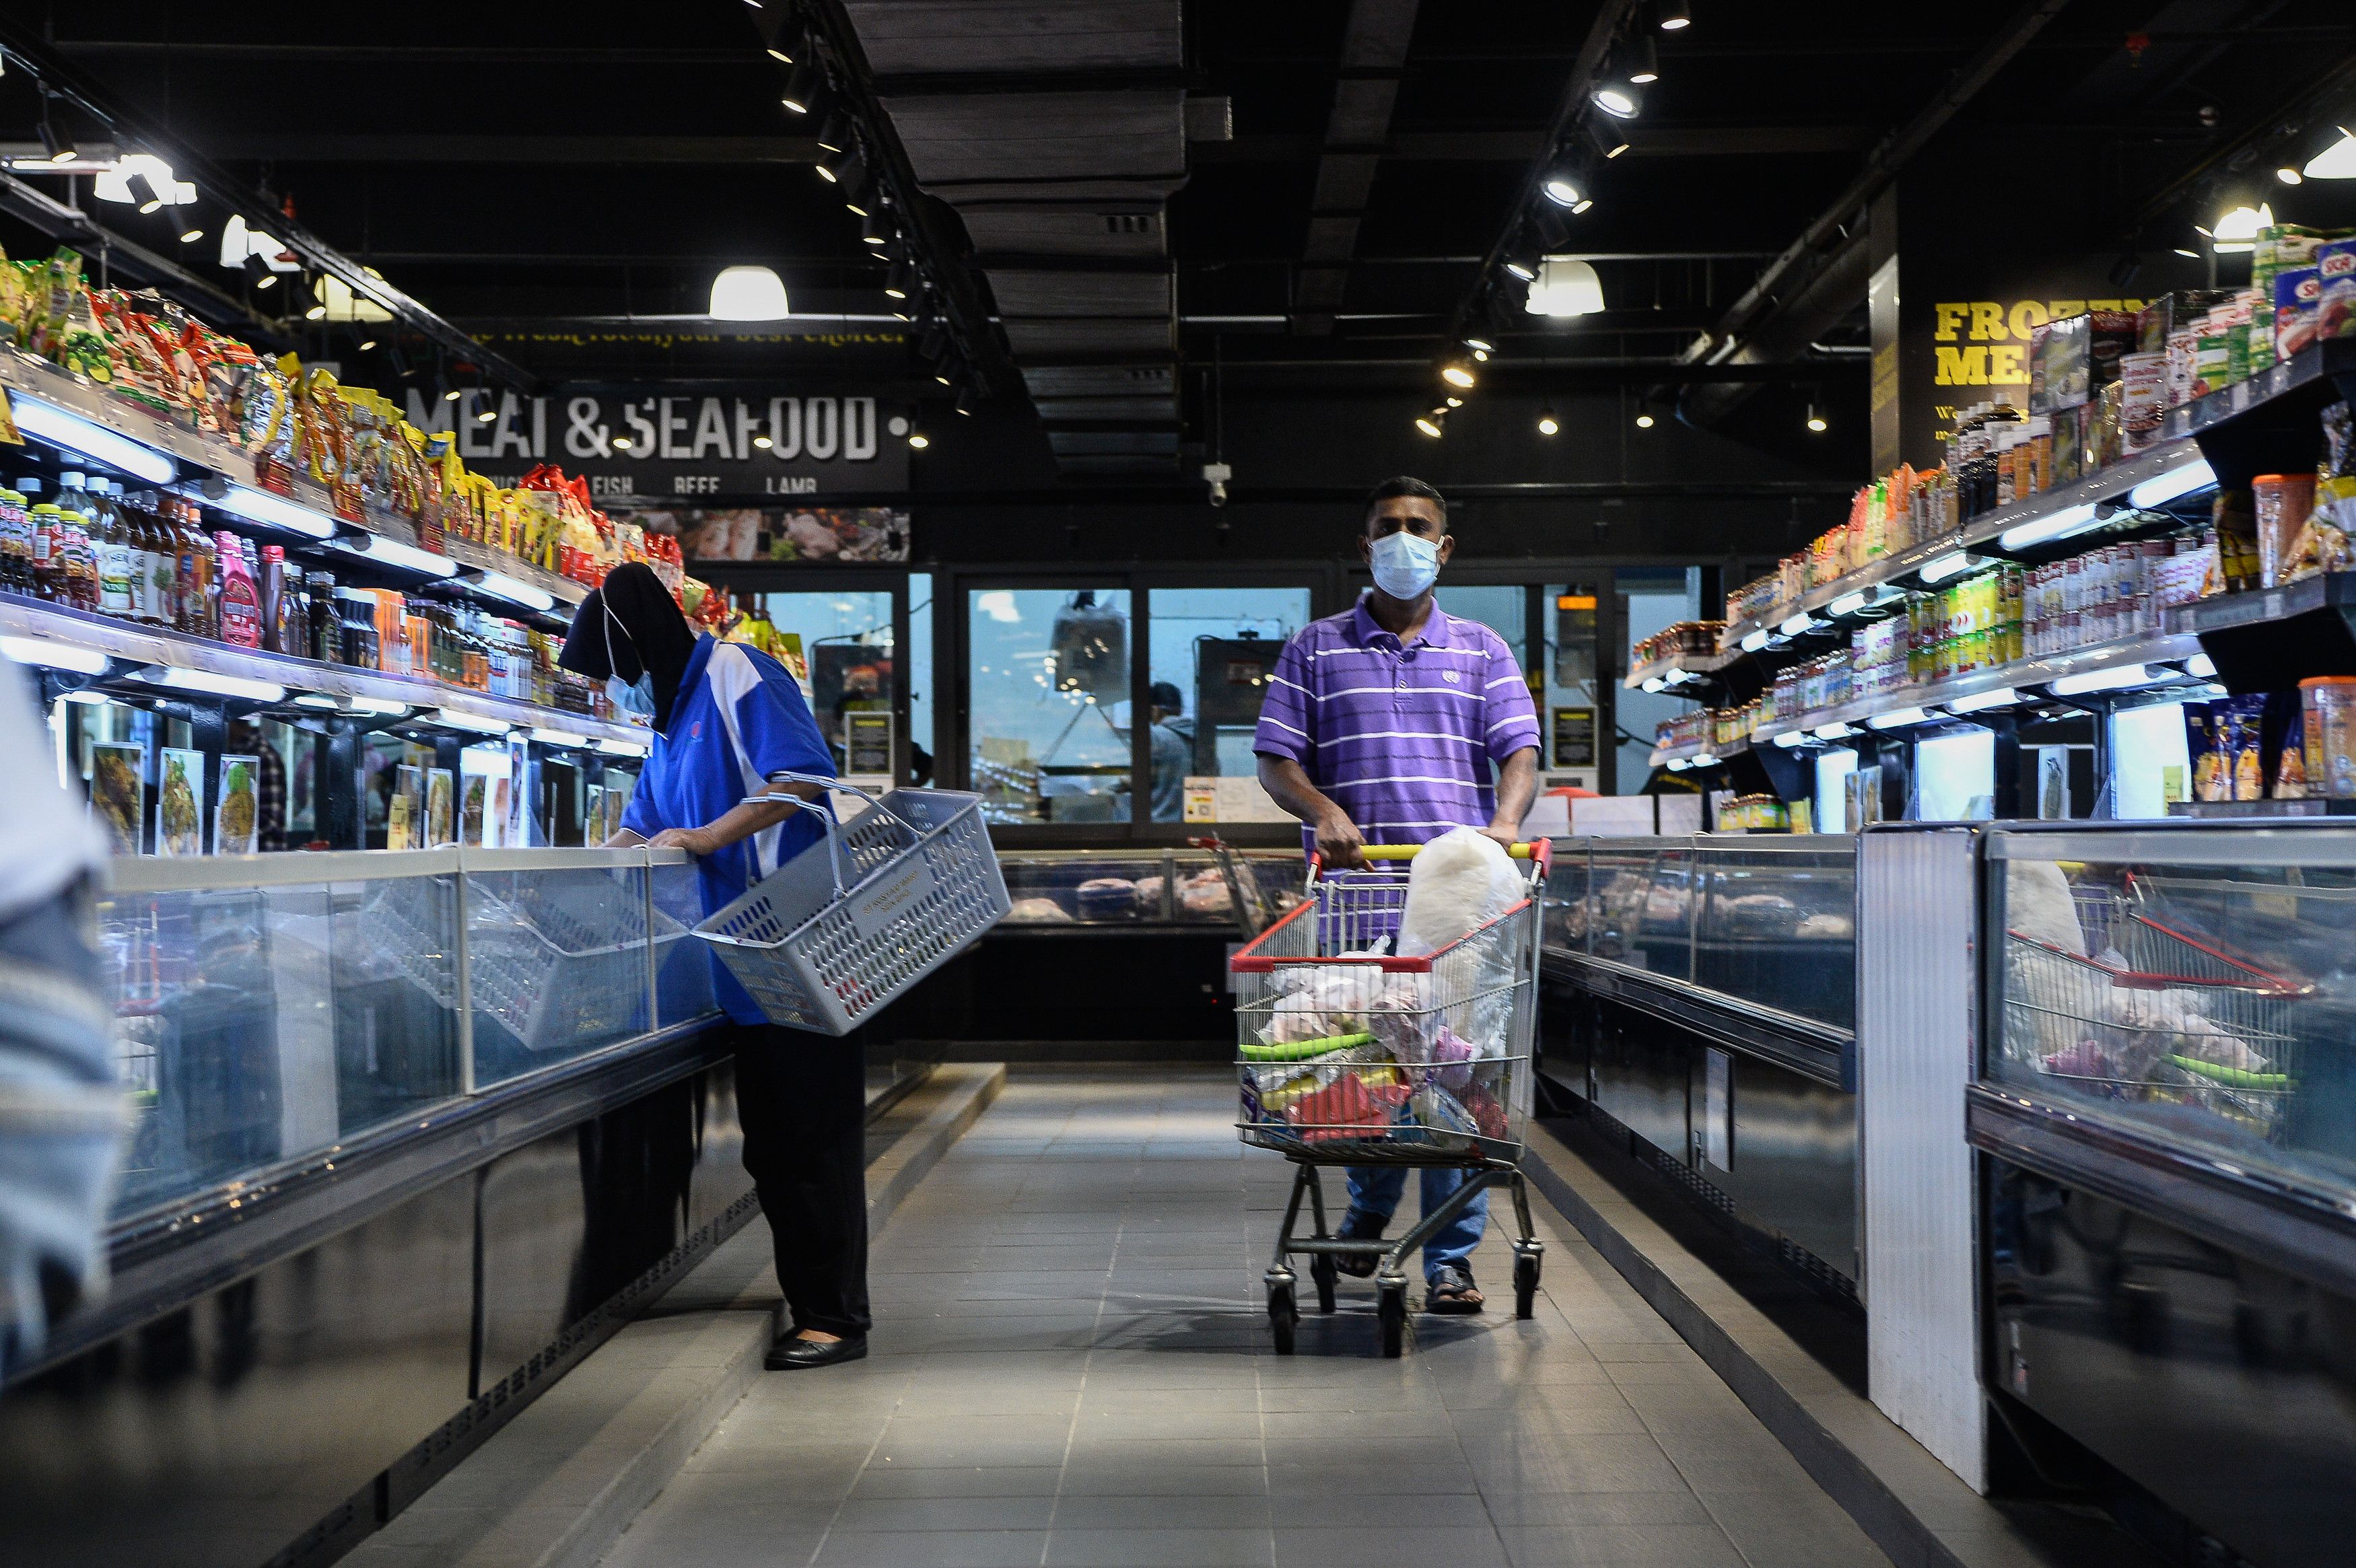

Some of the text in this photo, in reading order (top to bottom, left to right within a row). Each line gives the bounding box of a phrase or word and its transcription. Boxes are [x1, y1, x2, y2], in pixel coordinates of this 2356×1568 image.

[1935, 299, 2159, 341] FRO
[1935, 345, 2032, 385] ME
[404, 388, 877, 460] MEAT & SEAFOOD
[592, 476, 634, 495] FISH
